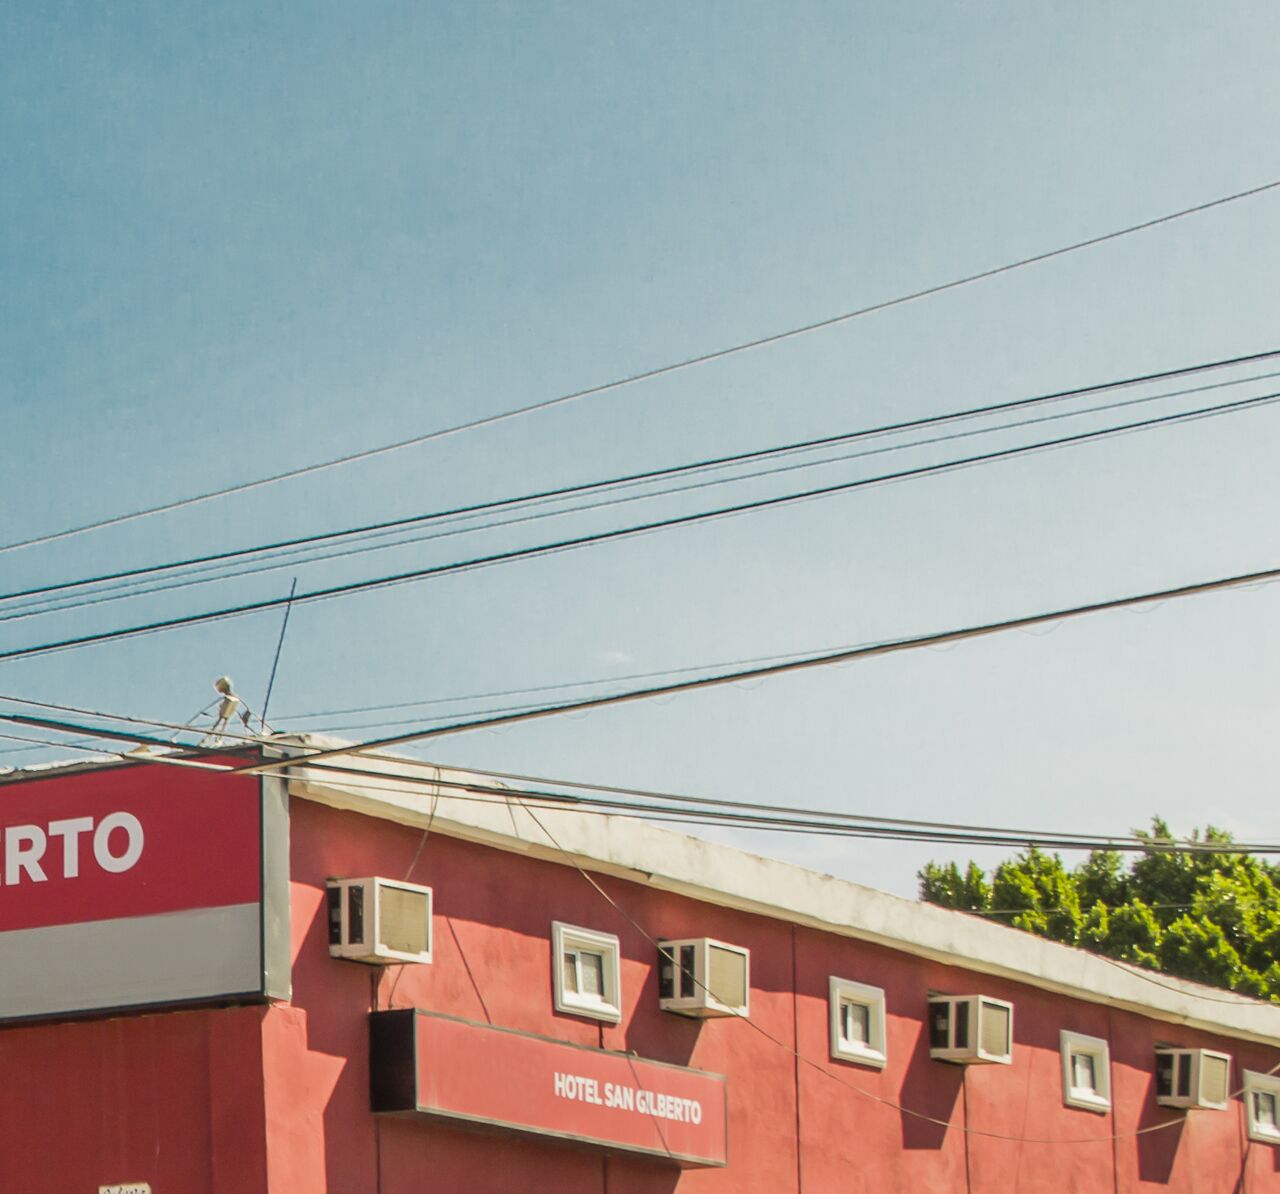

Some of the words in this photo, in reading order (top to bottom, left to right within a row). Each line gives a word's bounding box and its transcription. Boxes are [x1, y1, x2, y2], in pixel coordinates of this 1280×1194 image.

[554, 1072, 602, 1105] HOTEL
[604, 1082, 634, 1112] SAN
[636, 1090, 702, 1125] GILBERTO
